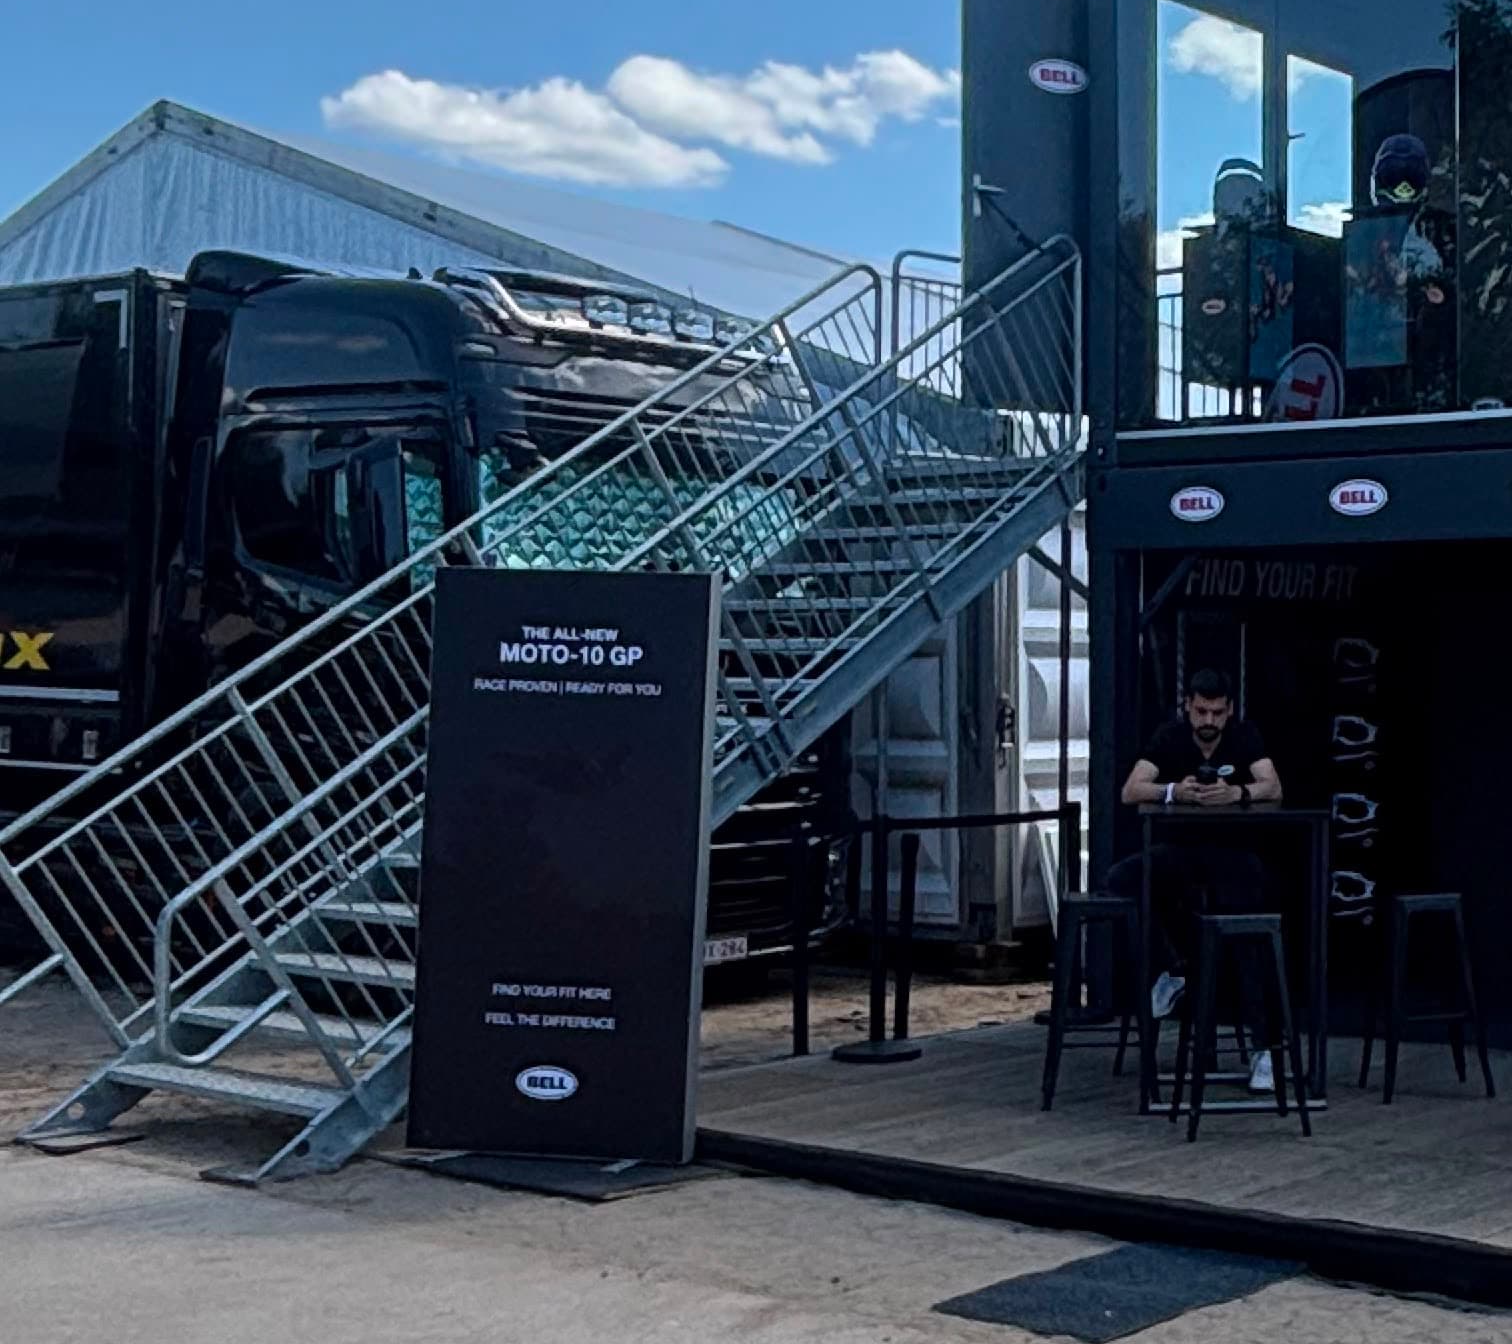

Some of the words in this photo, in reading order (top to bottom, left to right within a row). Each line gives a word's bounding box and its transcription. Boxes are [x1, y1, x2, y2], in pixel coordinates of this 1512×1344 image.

[1040, 68, 1080, 86] BELL
[1180, 497, 1215, 512] BELL
[1339, 490, 1378, 505] BELL
[1184, 558, 1246, 598] FIND
[1255, 560, 1317, 600] YOUR
[1321, 561, 1360, 601] FIT
[521, 626, 550, 640] THE
[553, 627, 618, 641] ALL-NEW
[500, 641, 604, 665] MOTO-10
[609, 646, 644, 665] GP
[474, 678, 506, 691] RACE
[509, 679, 557, 693] PROVEN
[565, 682, 604, 694] READY
[608, 683, 633, 694] FOR
[635, 684, 661, 696] YOU
[492, 983, 521, 996] FIND
[523, 984, 558, 997] YOUR
[559, 986, 577, 999] FIT
[579, 987, 612, 1000] HERE
[485, 1012, 514, 1025] FEEL
[516, 1013, 540, 1026] THE
[542, 1015, 616, 1030] DIFFERENCE
[527, 1076, 568, 1089] BELL
